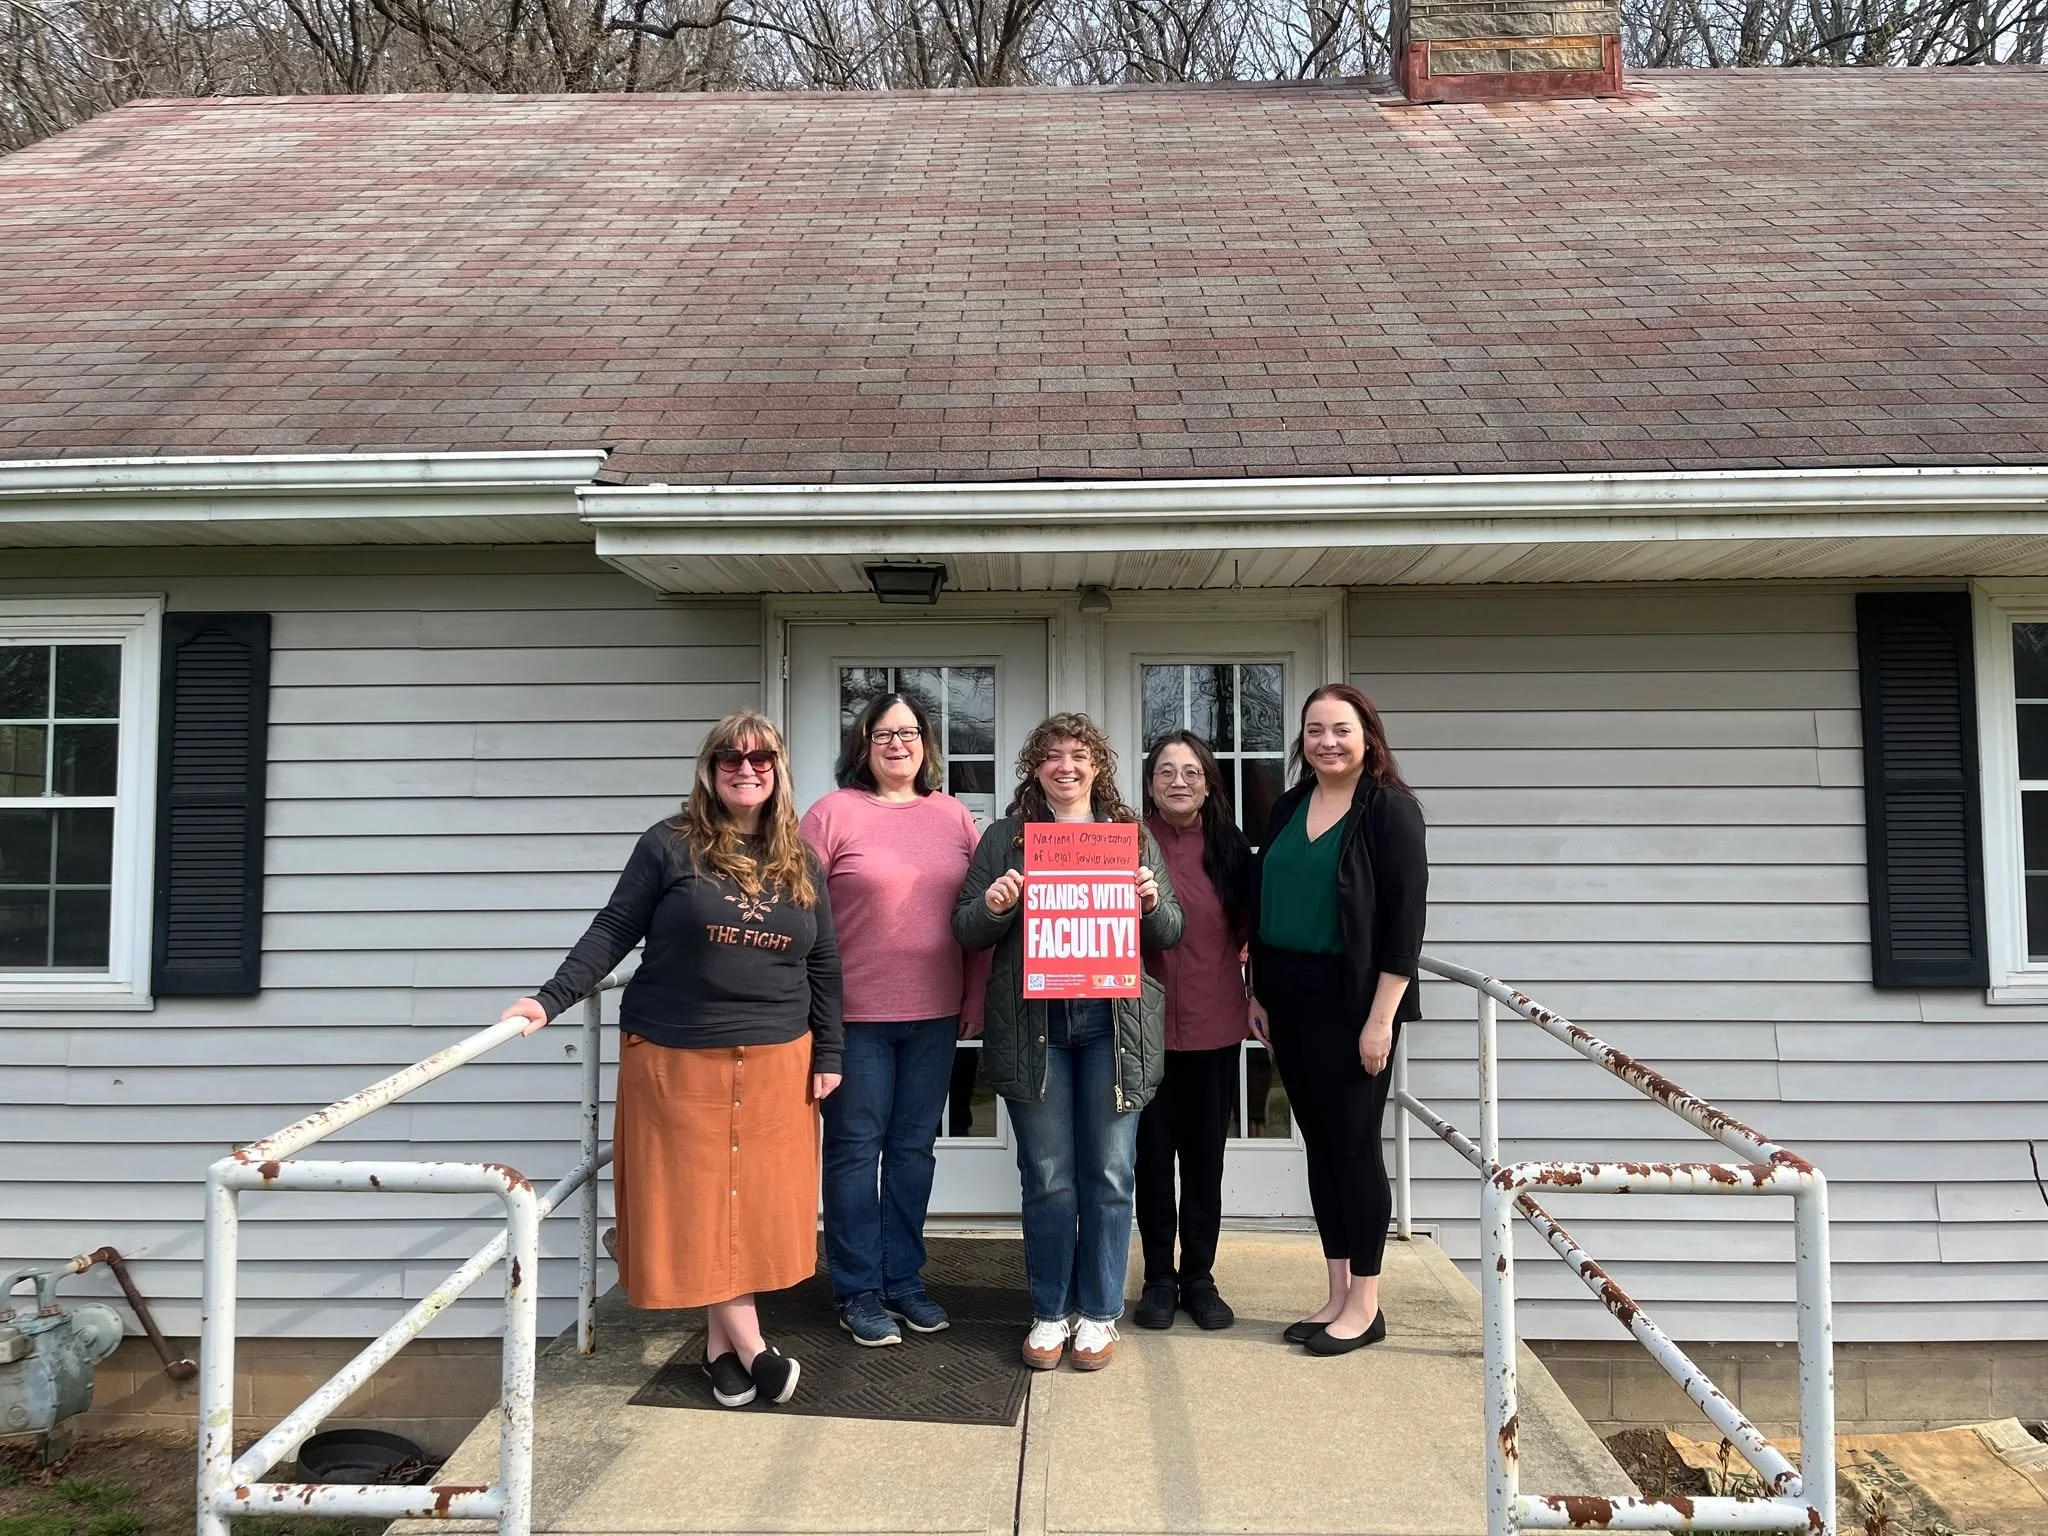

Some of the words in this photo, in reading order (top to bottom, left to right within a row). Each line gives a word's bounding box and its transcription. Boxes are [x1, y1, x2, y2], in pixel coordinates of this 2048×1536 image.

[1033, 832, 1075, 844] National
[1034, 850, 1044, 861] of
[1048, 851, 1071, 866] Legal
[1027, 883, 1089, 910] STANDS
[1092, 883, 1135, 910] WITH
[706, 924, 740, 944] THE
[743, 930, 792, 951] FIGHT
[1028, 917, 1136, 959] FACULTY!
